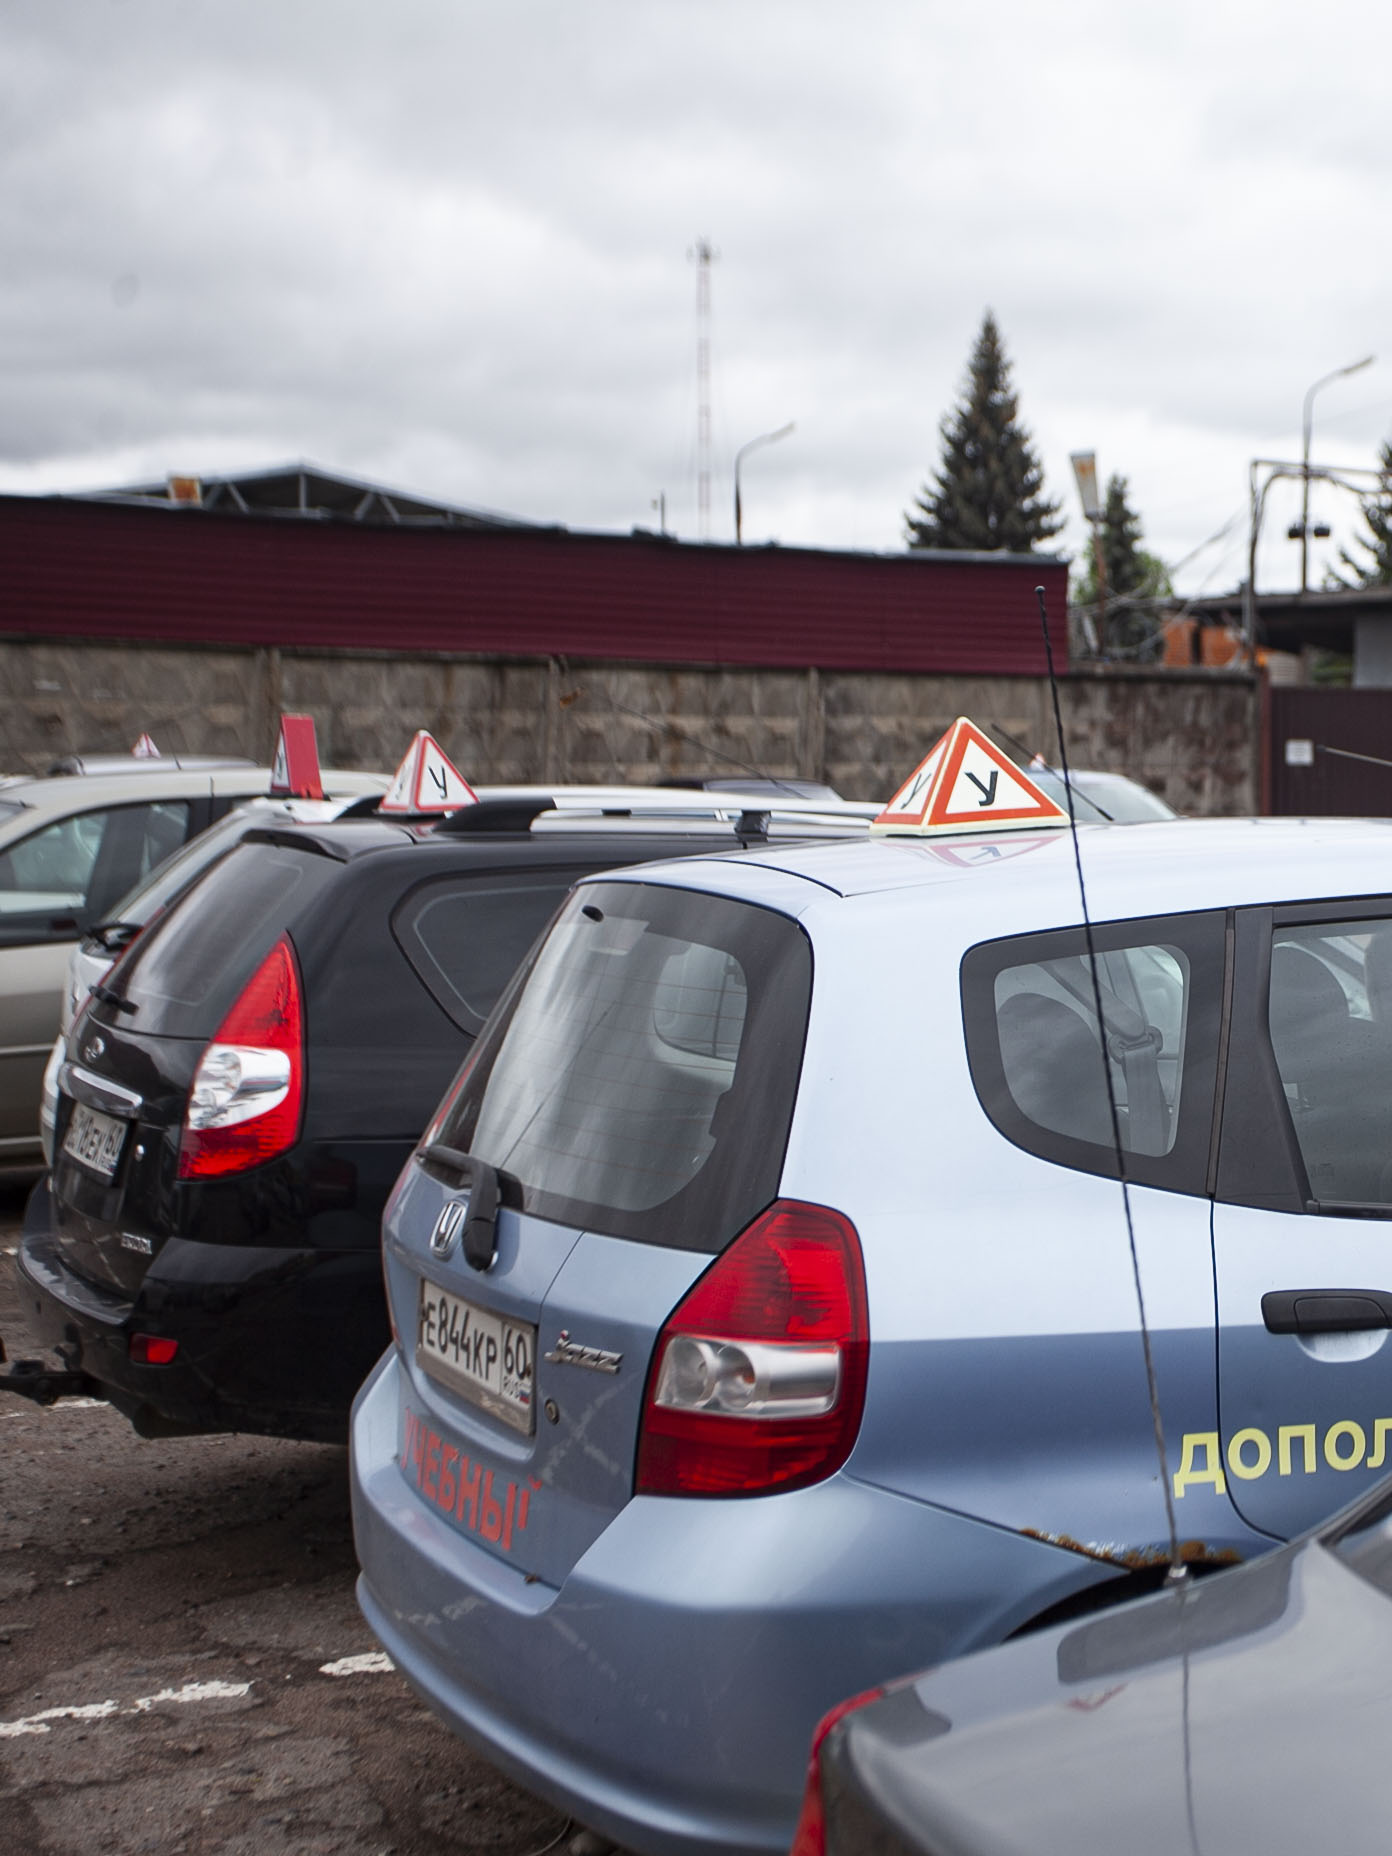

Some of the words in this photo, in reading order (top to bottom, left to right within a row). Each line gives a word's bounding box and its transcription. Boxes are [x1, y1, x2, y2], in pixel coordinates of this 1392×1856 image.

[427, 764, 449, 800] У
[900, 772, 932, 811] У
[964, 770, 999, 807] У
[503, 1327, 528, 1380] 60
